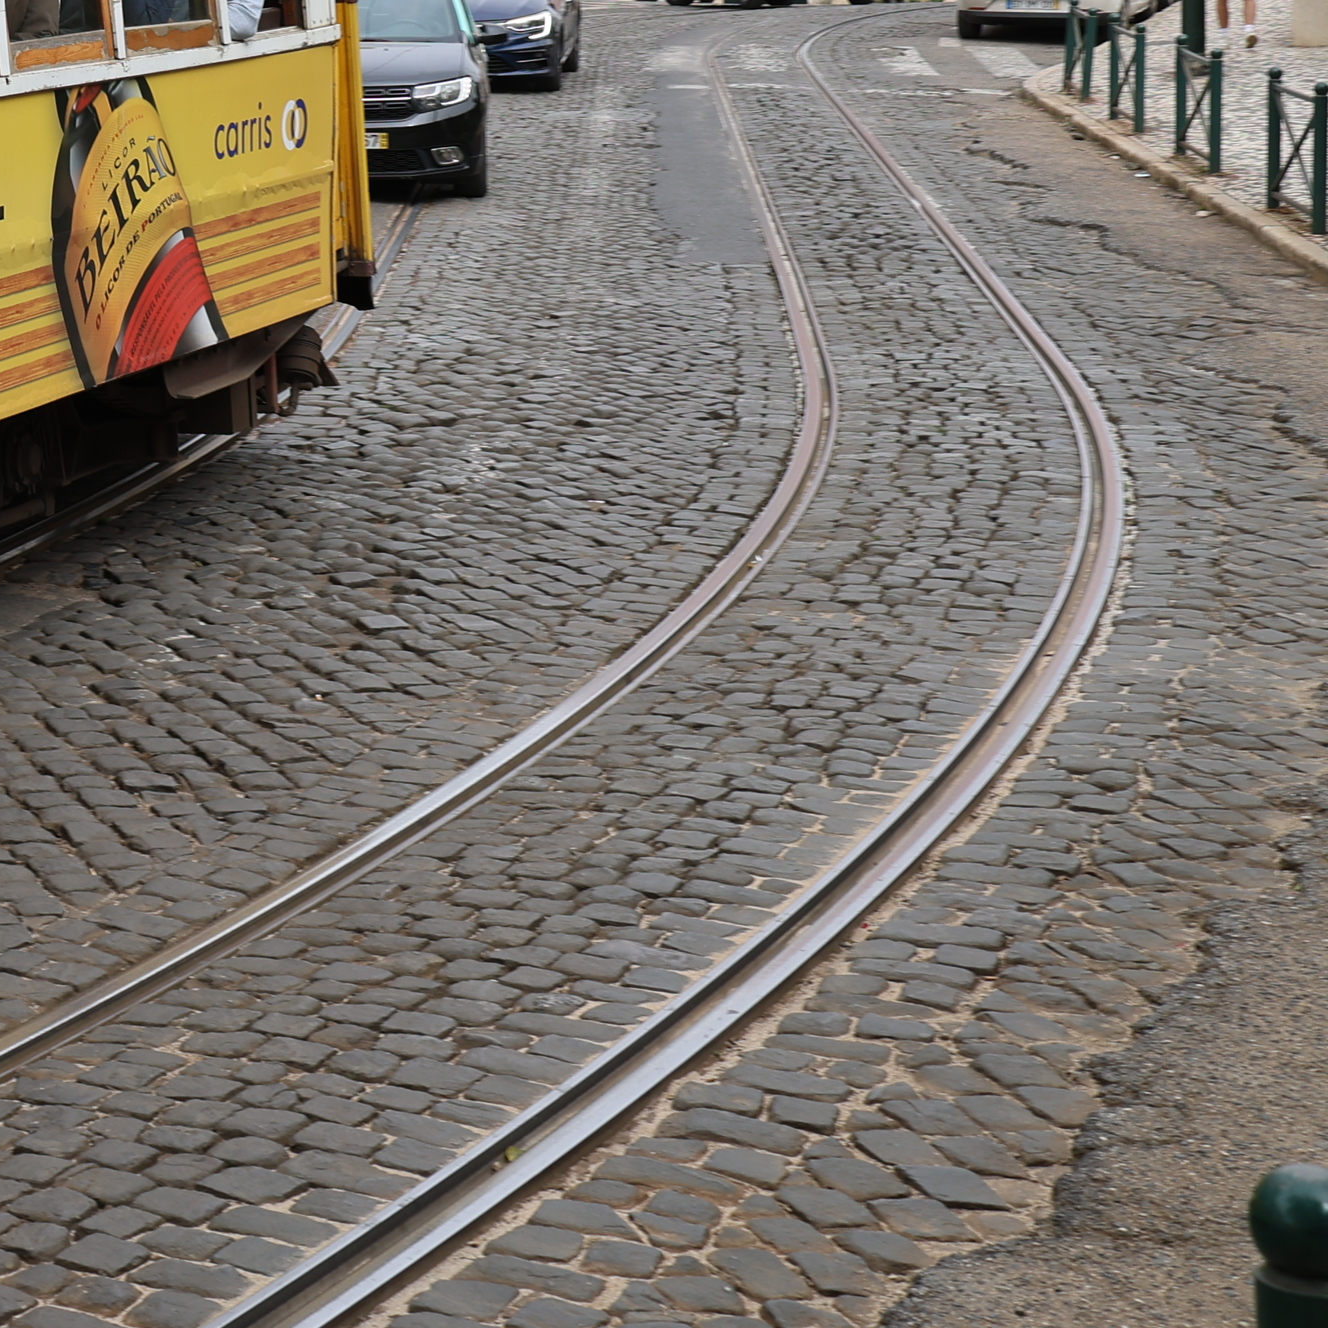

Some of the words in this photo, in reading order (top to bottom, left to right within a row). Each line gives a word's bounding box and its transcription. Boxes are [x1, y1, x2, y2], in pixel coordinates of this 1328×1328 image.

[214, 101, 273, 160] carris
[102, 137, 136, 191] LICOR
[75, 135, 177, 325] BEIRÃO
[100, 255, 126, 314] LICOR
